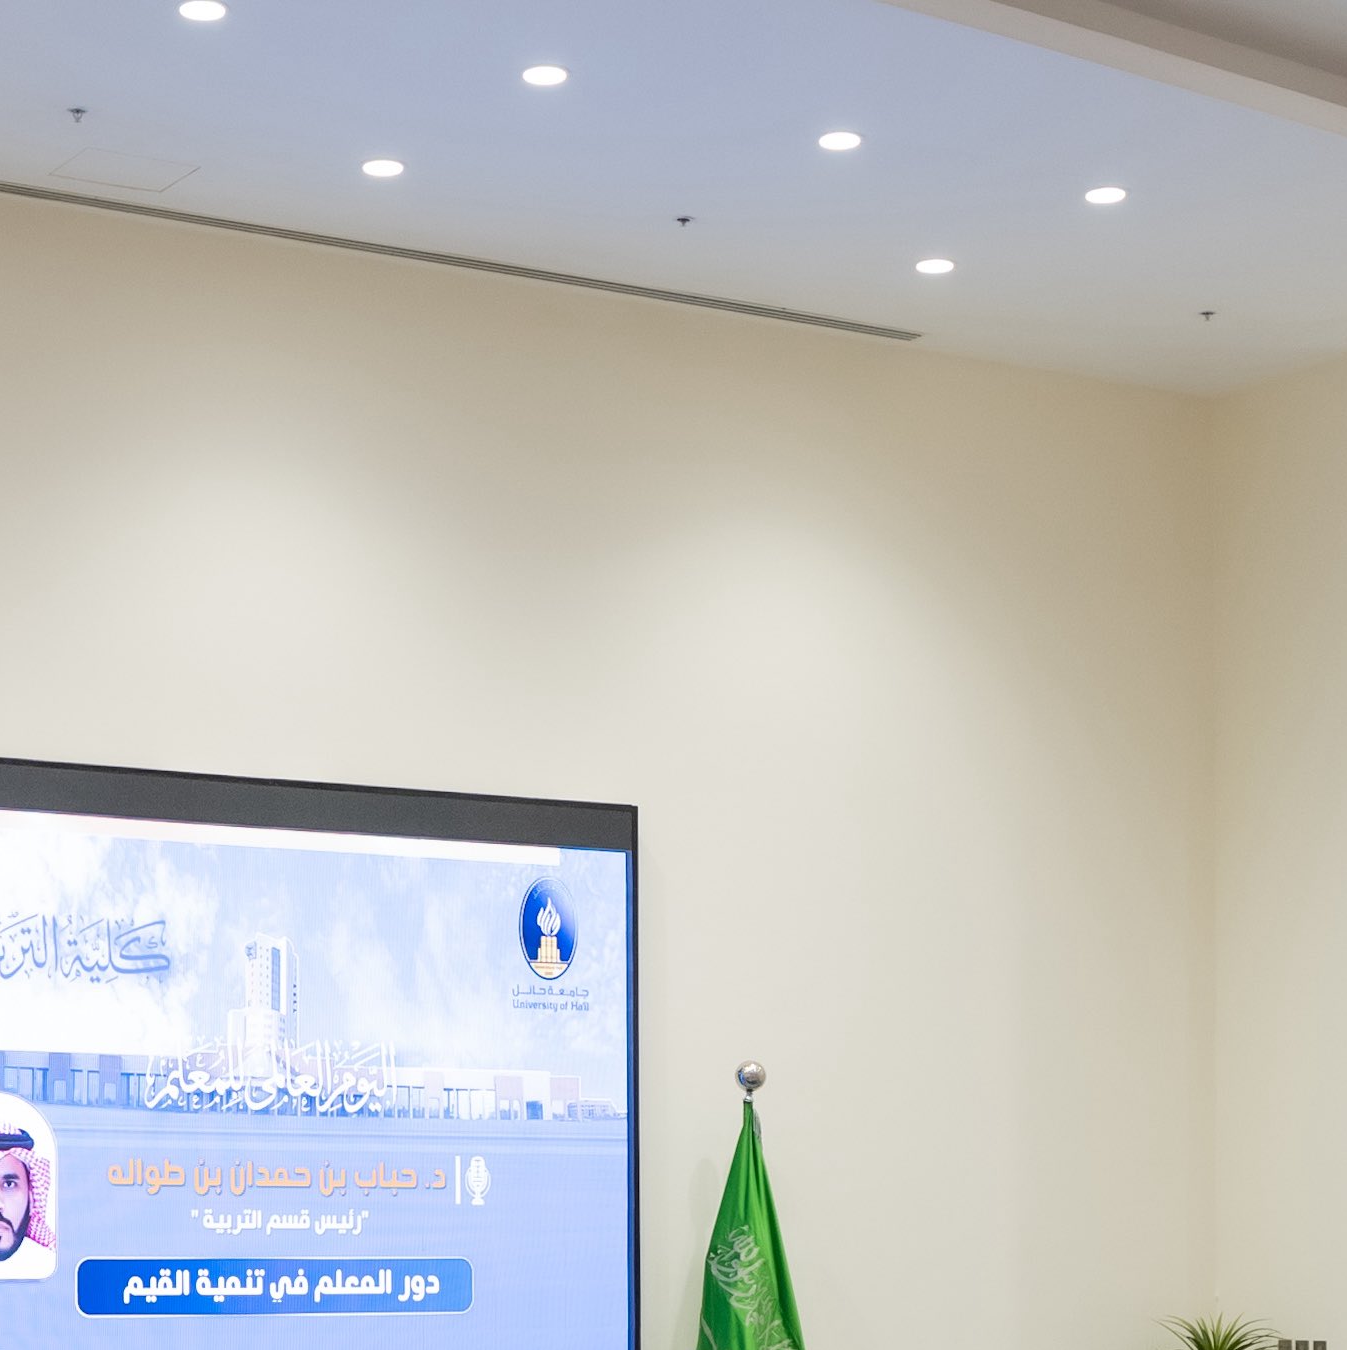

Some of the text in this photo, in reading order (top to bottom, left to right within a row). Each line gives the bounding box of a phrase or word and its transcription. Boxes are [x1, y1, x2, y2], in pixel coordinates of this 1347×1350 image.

[513, 1000, 558, 1012] University
[559, 1001, 568, 1011] of
[193, 1159, 221, 1196] بن
[230, 1160, 312, 1197] حمدان
[319, 1160, 346, 1197] بن
[354, 1162, 417, 1195] حباب
[265, 1209, 310, 1236] قسم
[123, 1269, 440, 1304] دور المعلم في تنمية القيم
